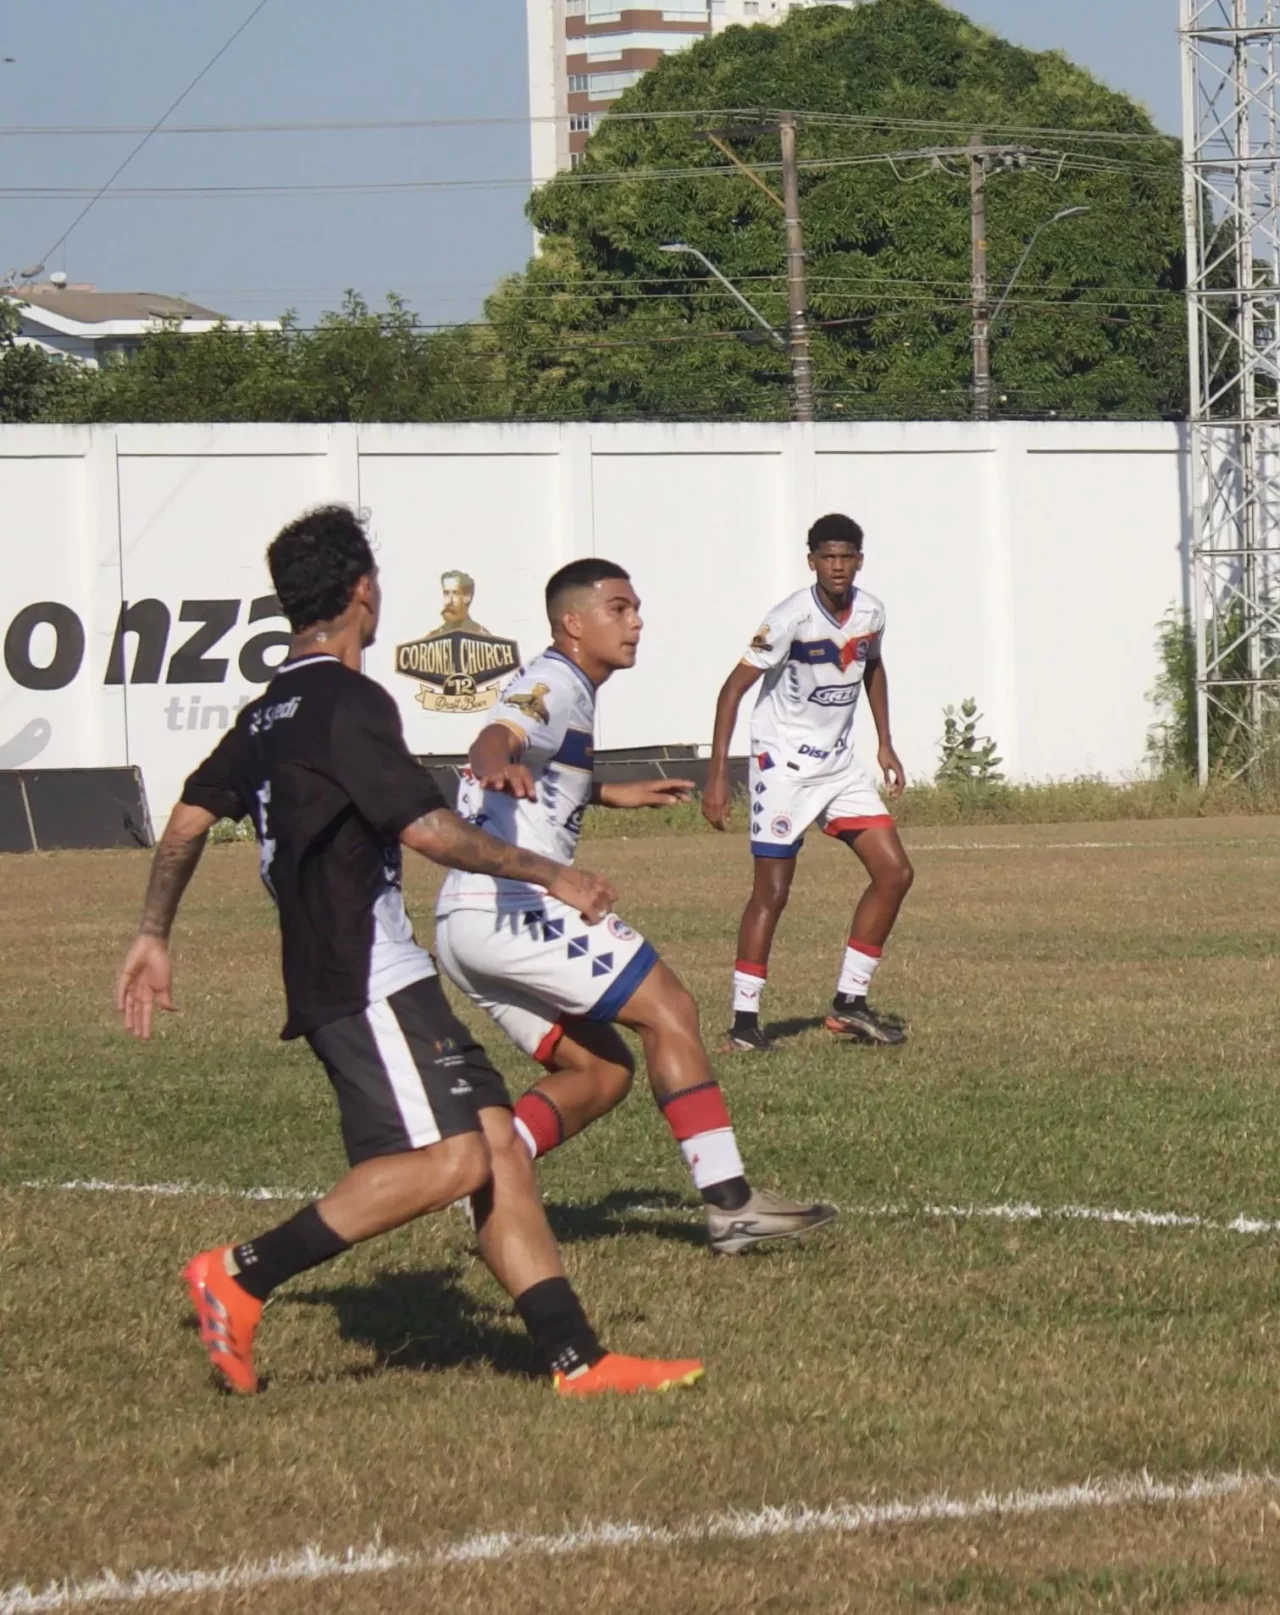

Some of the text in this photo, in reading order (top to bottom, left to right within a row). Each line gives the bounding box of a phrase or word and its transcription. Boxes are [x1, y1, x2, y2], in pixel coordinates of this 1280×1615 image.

[400, 638, 514, 676] CORONEL CHURCH
[164, 695, 249, 731] tin
